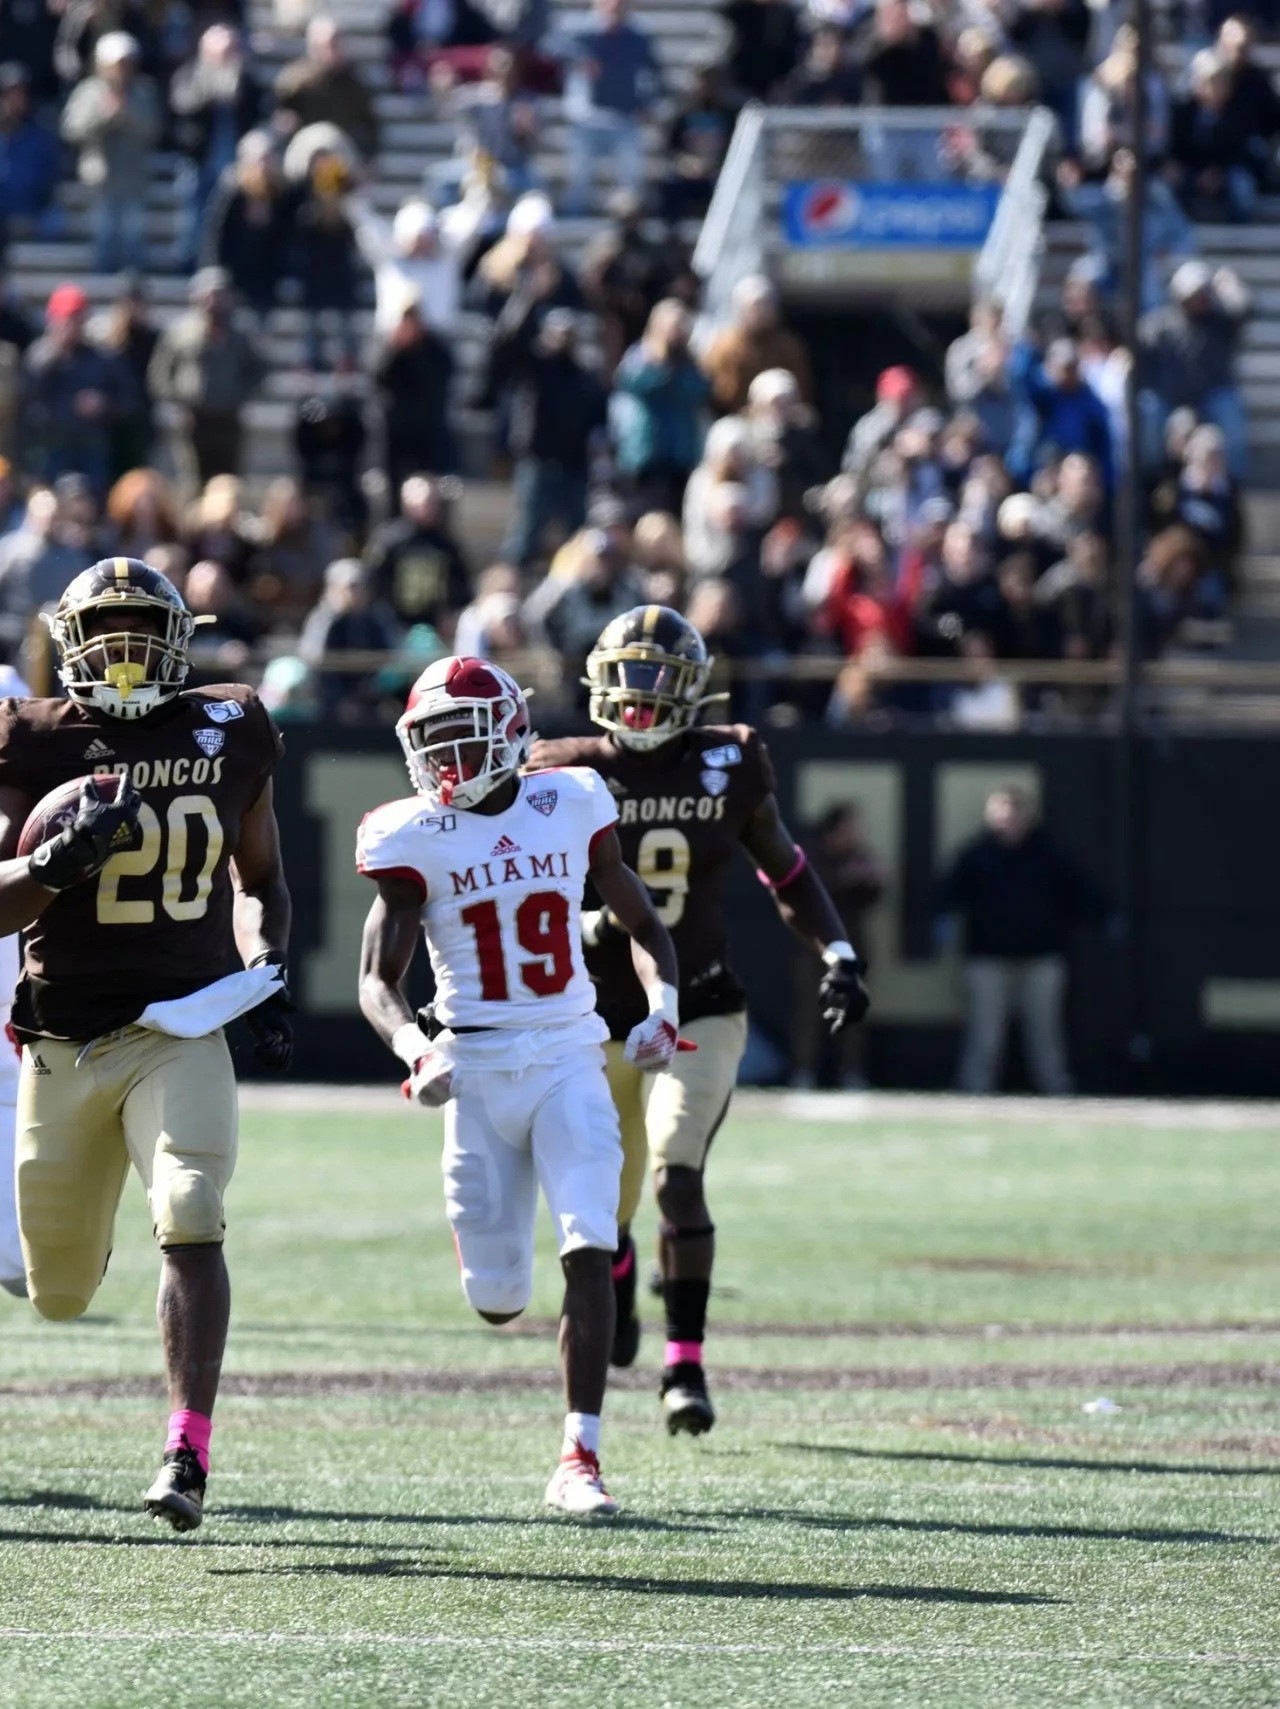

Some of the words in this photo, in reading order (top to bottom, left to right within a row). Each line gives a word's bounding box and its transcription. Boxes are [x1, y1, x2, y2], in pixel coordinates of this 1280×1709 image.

[617, 796, 728, 825] RONCOS
[96, 795, 224, 924] 20
[449, 852, 569, 896] MIAMI
[491, 845, 522, 857] adidas
[638, 828, 690, 928] 9
[460, 890, 575, 1001] 19
